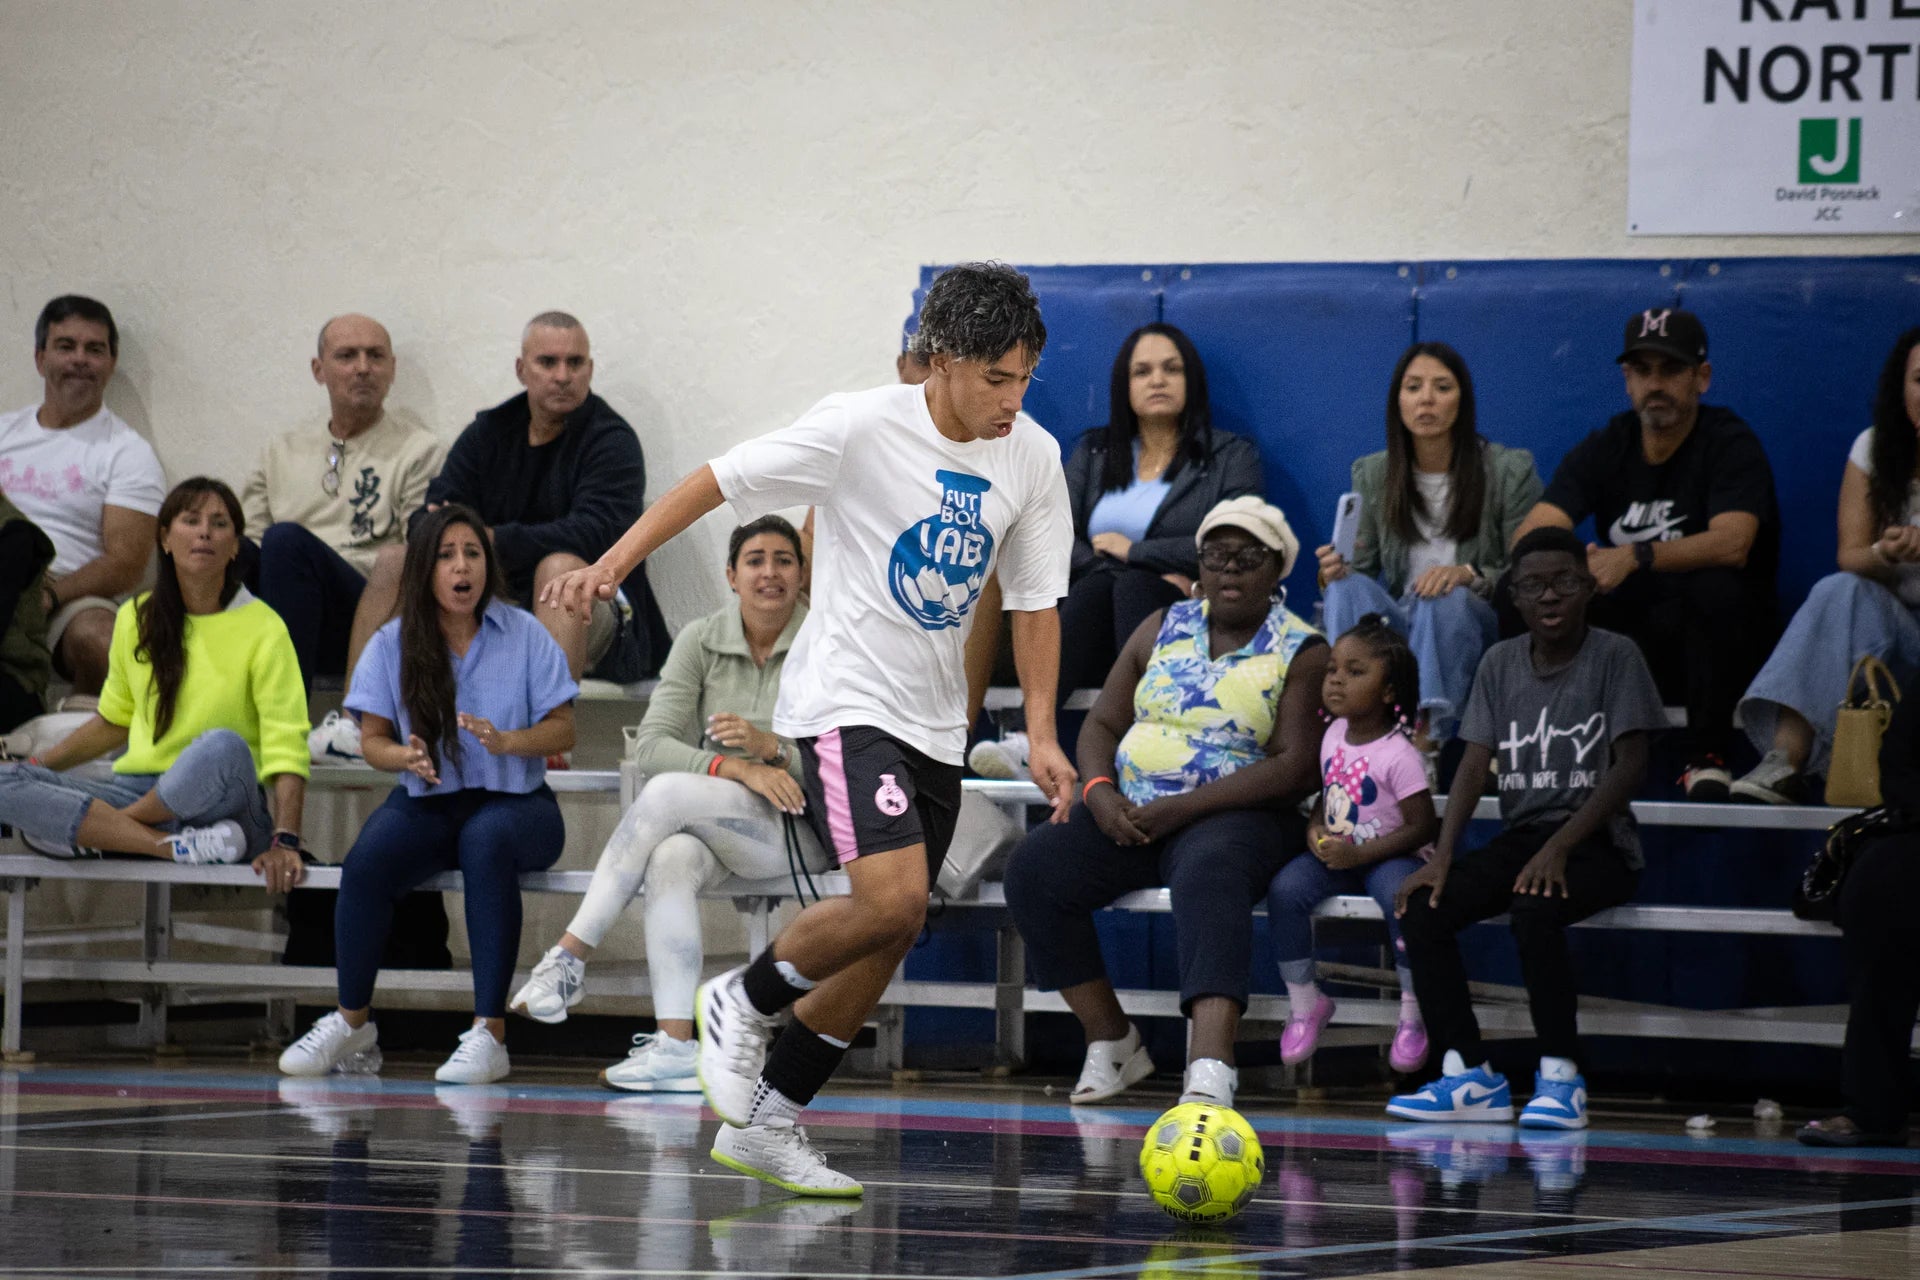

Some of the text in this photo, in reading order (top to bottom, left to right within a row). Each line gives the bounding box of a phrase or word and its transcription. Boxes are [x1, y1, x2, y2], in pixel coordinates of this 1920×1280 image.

[1704, 44, 1920, 103] NORT
[1776, 187, 1880, 201] David Posnack
[1814, 207, 1842, 221] JCC
[946, 489, 979, 512] FUT
[941, 505, 978, 530] BOL
[1621, 500, 1675, 528] NIKE
[919, 522, 986, 568] LAB
[1498, 769, 1597, 791] FAITH HOPE LOVE
